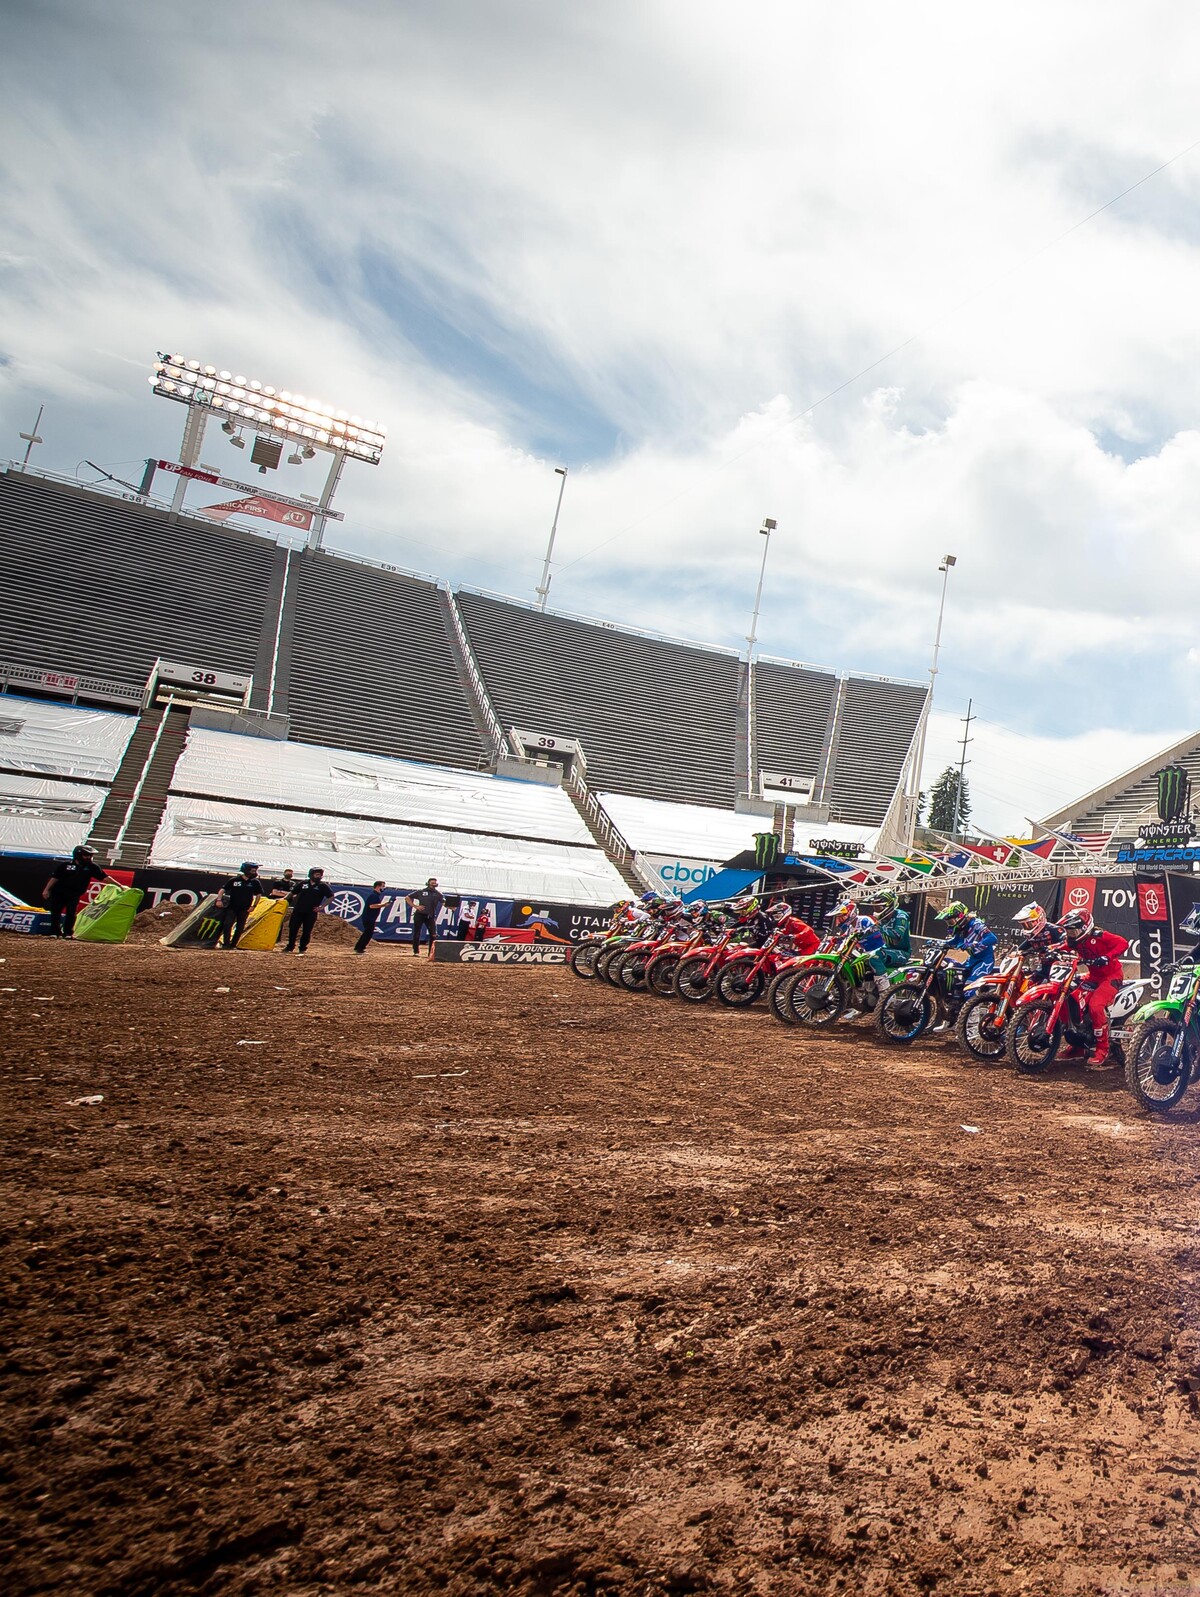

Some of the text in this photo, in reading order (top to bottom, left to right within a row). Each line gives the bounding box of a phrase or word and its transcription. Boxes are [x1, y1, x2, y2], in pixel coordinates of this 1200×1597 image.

[191, 671, 216, 685] 38
[538, 737, 556, 748] 39
[780, 777, 793, 787] 41
[1140, 824, 1191, 838] MONSTER
[810, 840, 865, 852] MONSTER
[1147, 837, 1184, 845] ENERGY
[992, 883, 1034, 893] MONSTER
[375, 895, 497, 927] YAAHA
[478, 943, 566, 953] ROCKY MOUNTAIN
[1050, 966, 1072, 982] 27
